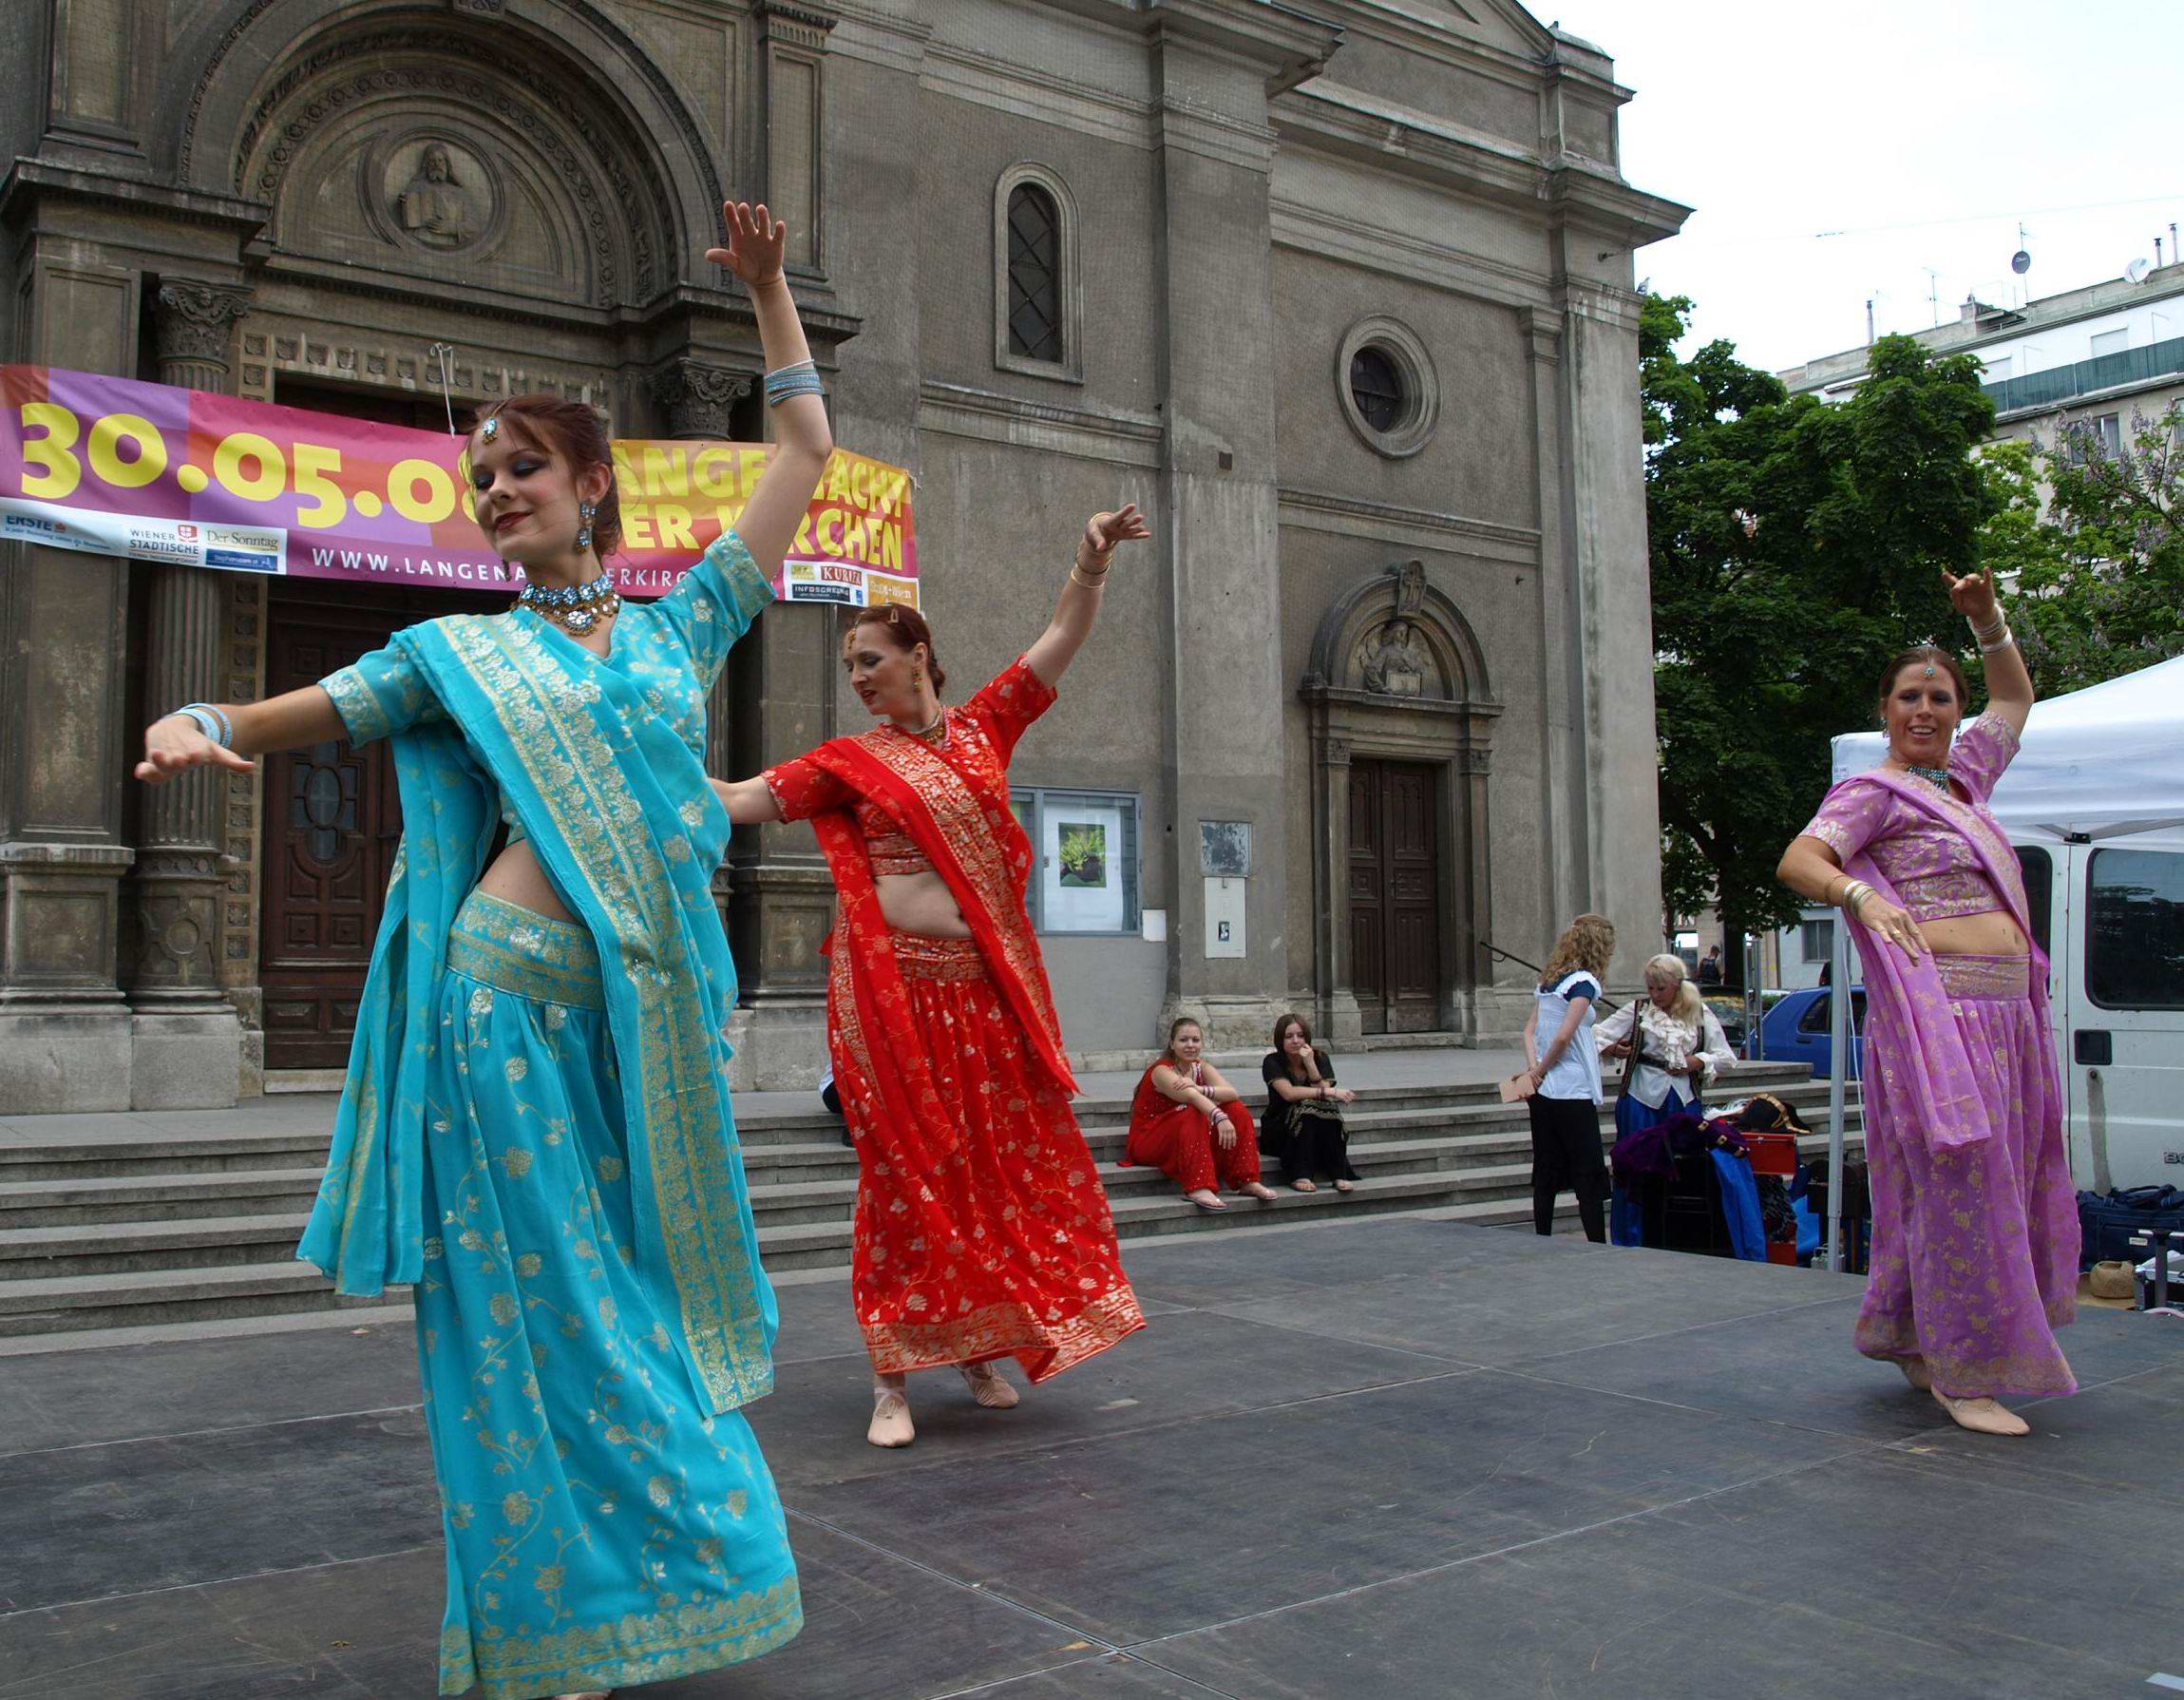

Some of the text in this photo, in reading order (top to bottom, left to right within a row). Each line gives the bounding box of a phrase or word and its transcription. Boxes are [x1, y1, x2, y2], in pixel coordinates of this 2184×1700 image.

[21, 401, 479, 529] 30.05.0
[611, 447, 767, 498] ANGE
[130, 528, 176, 541] WIENER
[207, 530, 277, 547] Der Sonntag
[619, 503, 700, 549] ER
